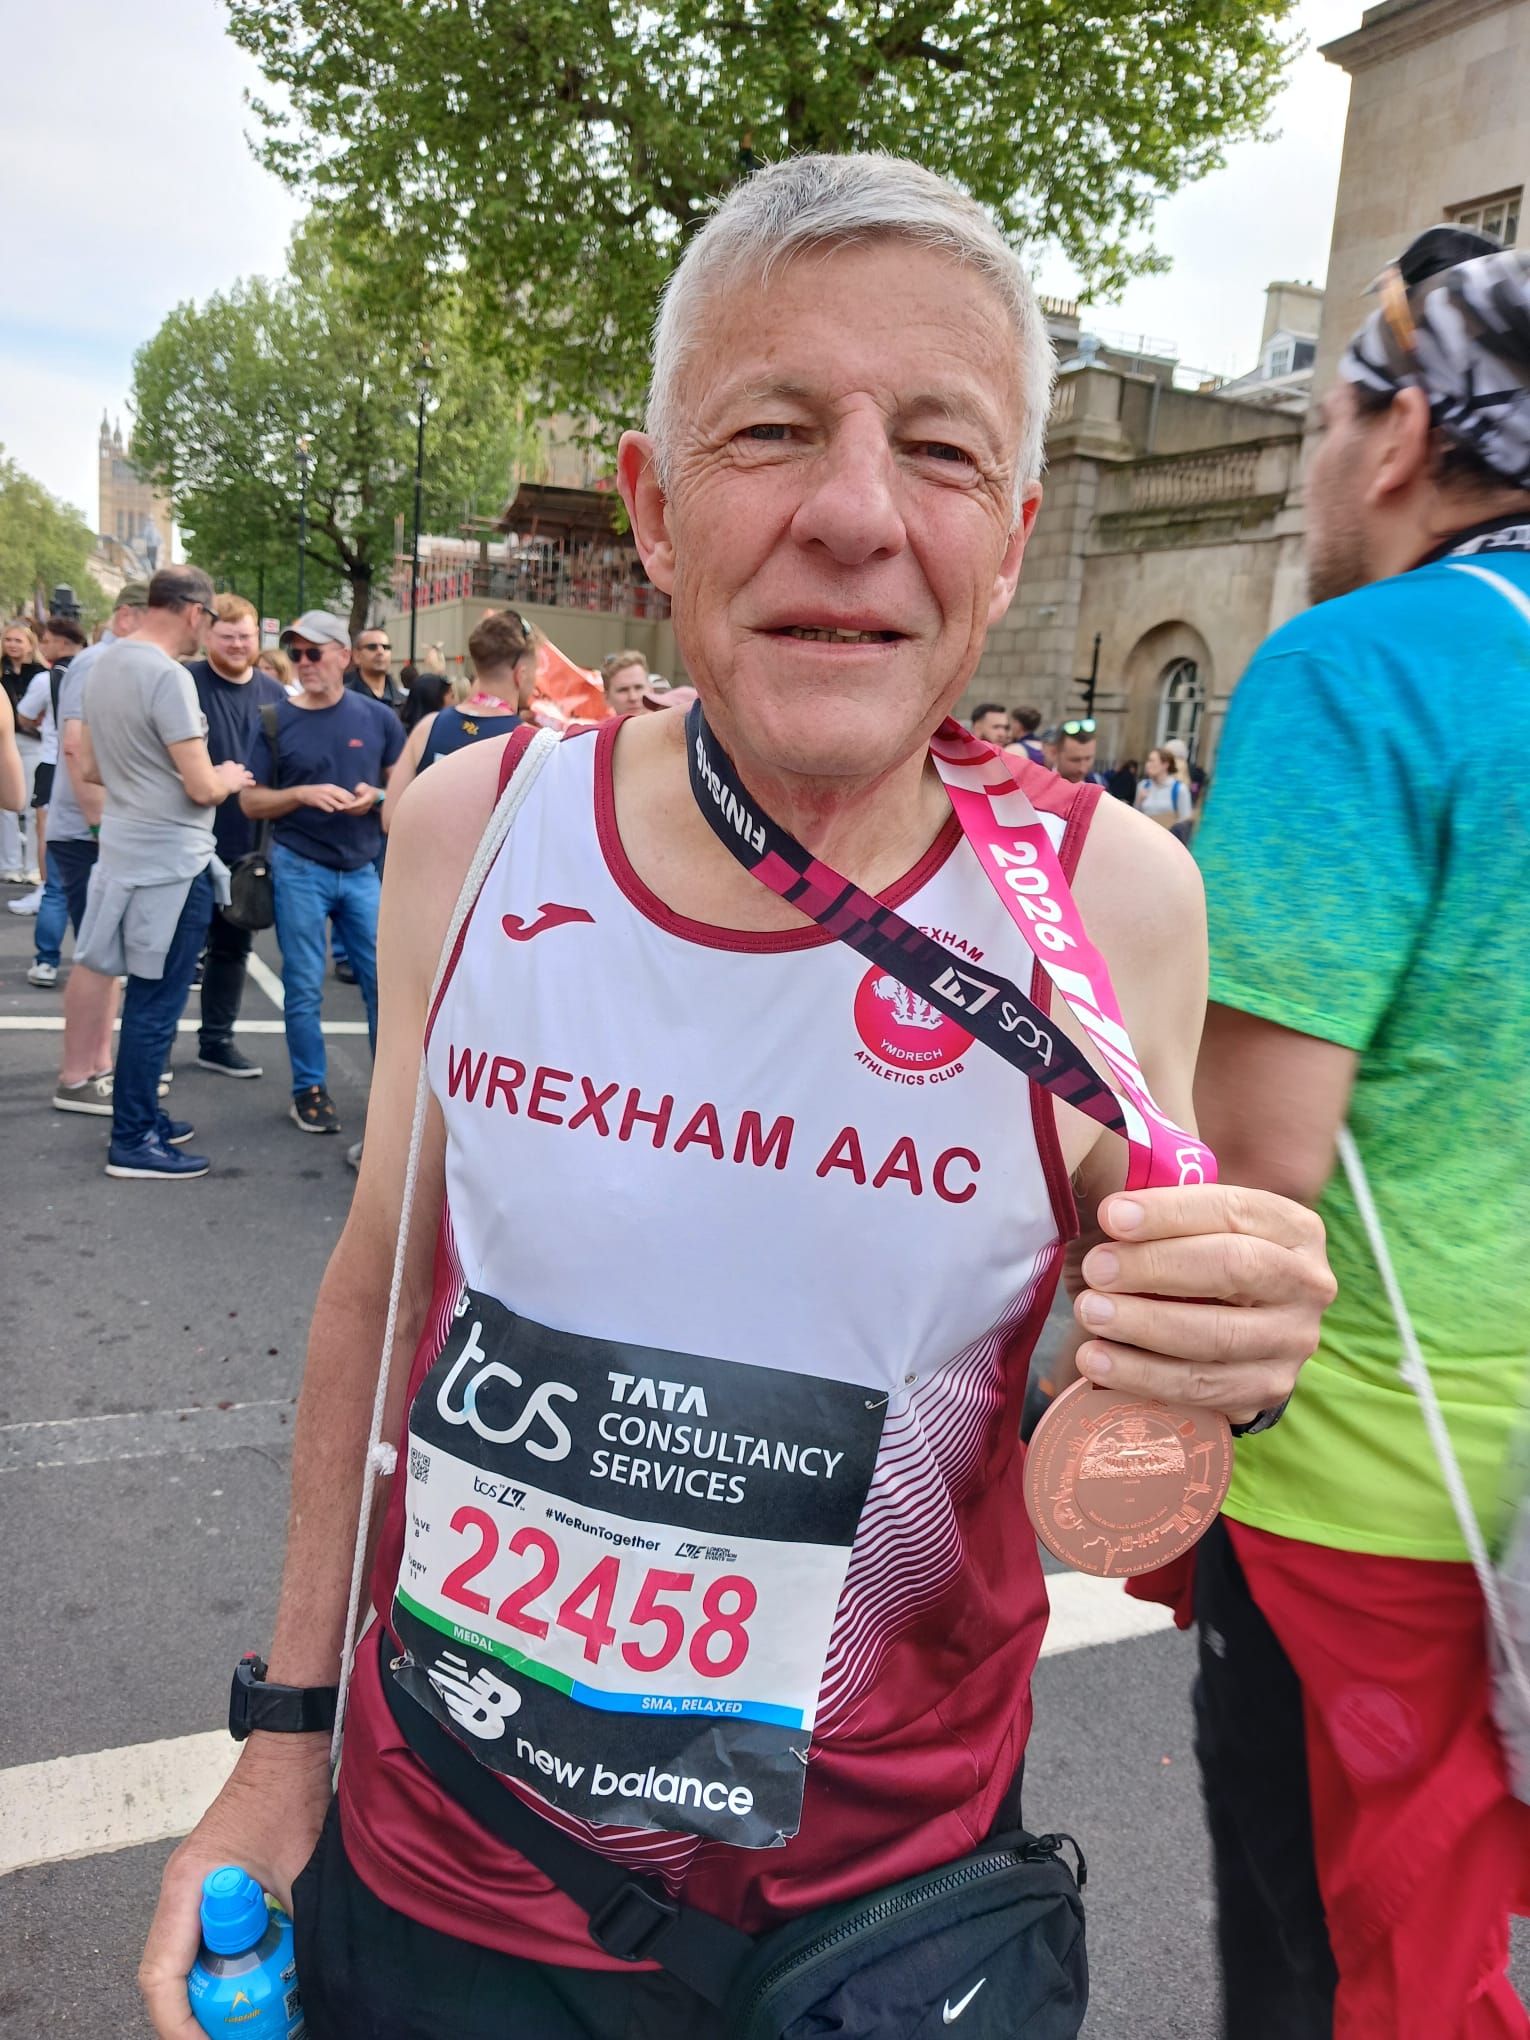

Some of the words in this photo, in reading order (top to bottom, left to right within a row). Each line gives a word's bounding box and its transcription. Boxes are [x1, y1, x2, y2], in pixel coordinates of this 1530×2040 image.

[988, 841, 1078, 952] 2026
[880, 1038, 943, 1062] YMDRECH
[999, 1001, 1053, 1067] tcs
[854, 1050, 925, 1085] ATHLETICS
[929, 1062, 965, 1083] CLUB
[448, 1044, 796, 1171] WREXHAM
[816, 1125, 981, 1203] AAC
[437, 1321, 578, 1461] tcs
[608, 1371, 708, 1417] TATA
[598, 1412, 845, 1479] CONSULTANCY
[473, 1476, 498, 1498] tcs
[589, 1450, 747, 1504] SERVICES
[546, 1508, 661, 1551] #WeRunTogether
[440, 1505, 758, 1678] 22458
[453, 1625, 494, 1653] MEDAL
[641, 1697, 678, 1713] SMA,
[681, 1698, 743, 1714] RELAXED
[517, 1736, 585, 1789] new
[590, 1763, 754, 1816] balance
